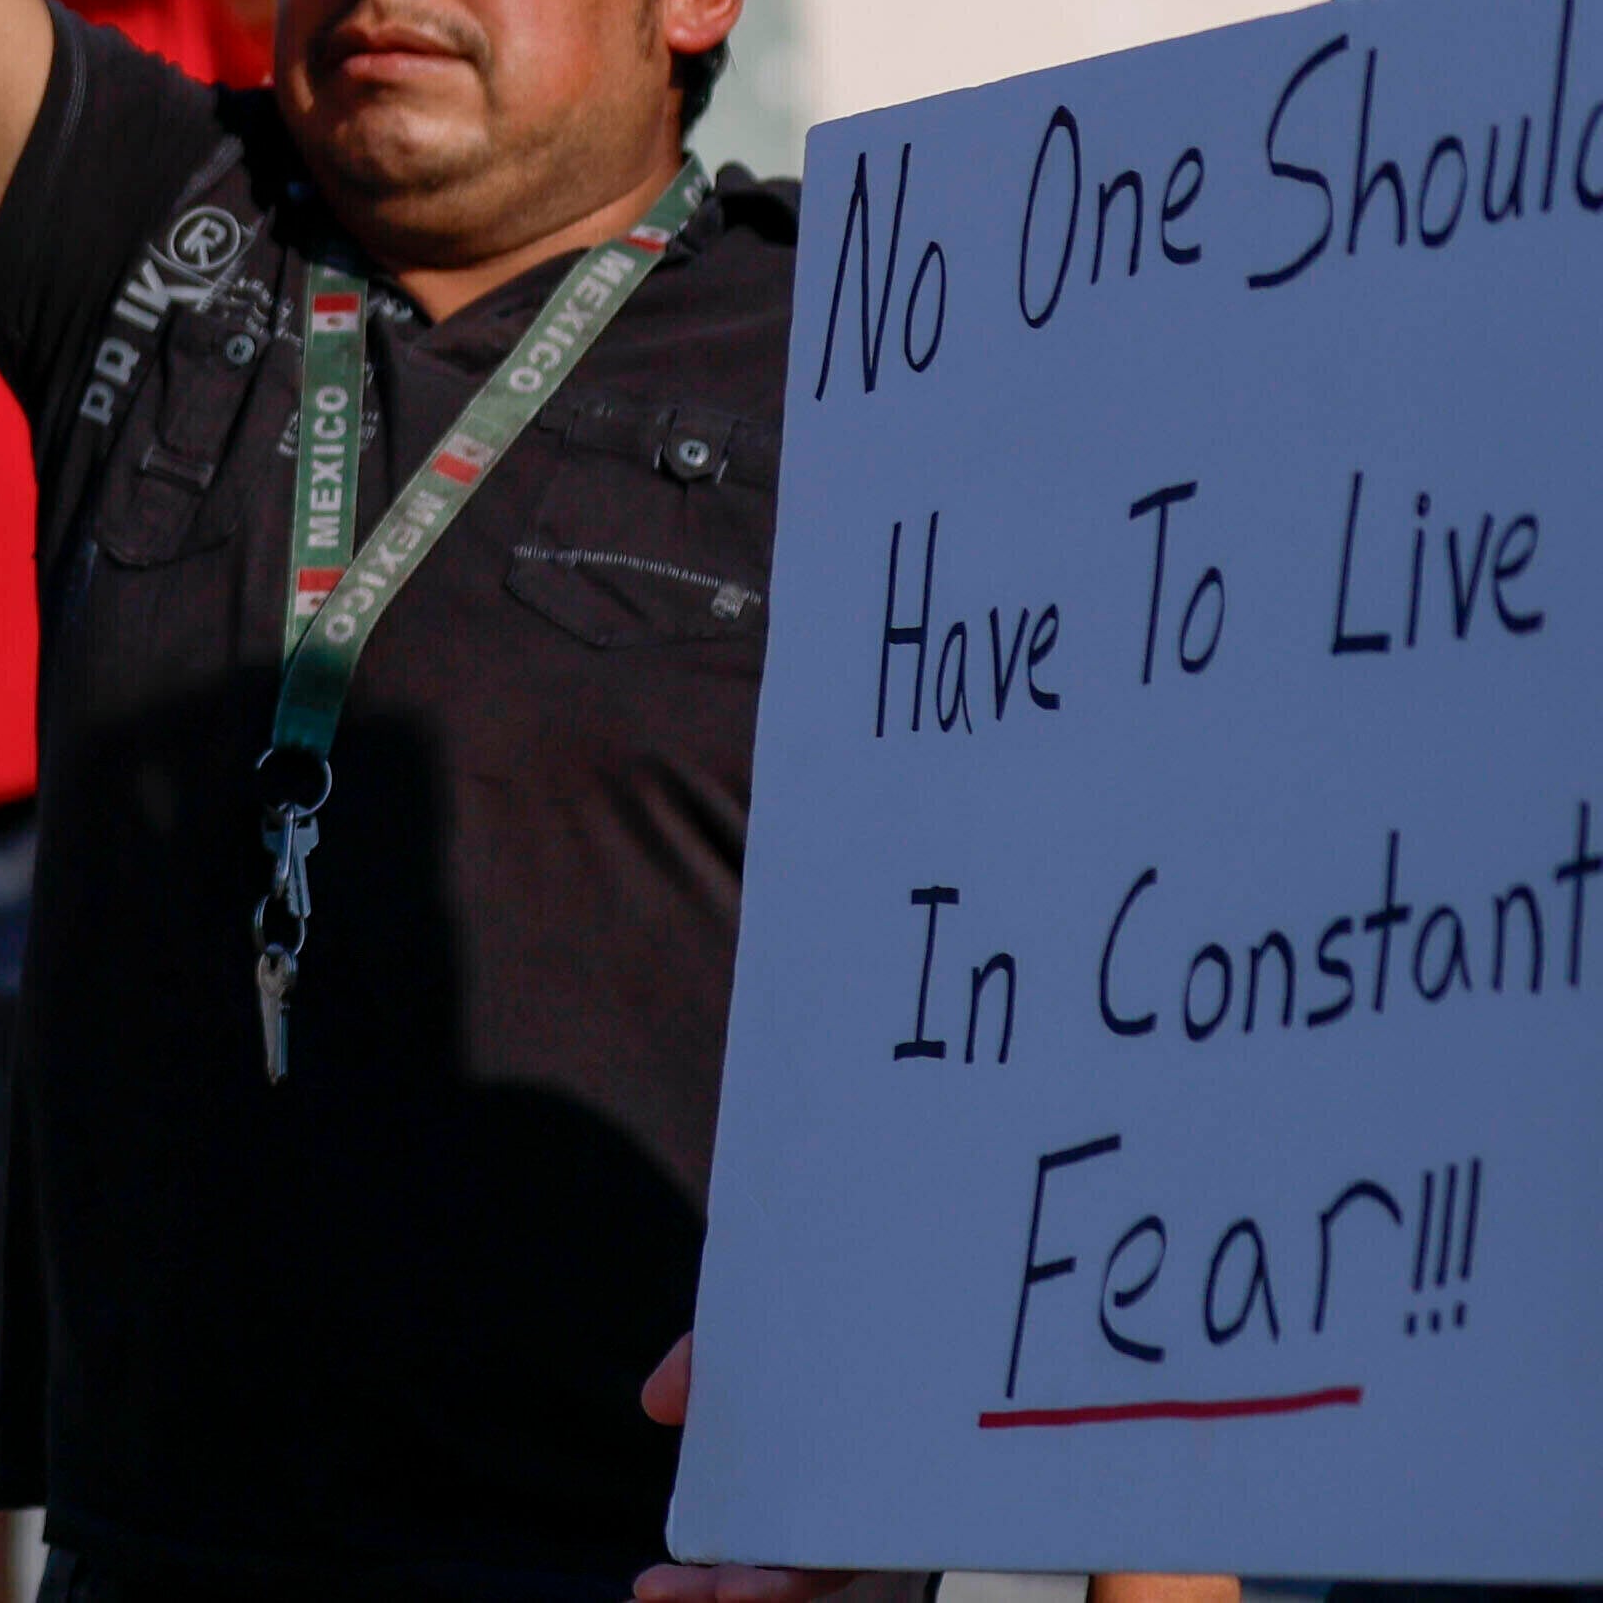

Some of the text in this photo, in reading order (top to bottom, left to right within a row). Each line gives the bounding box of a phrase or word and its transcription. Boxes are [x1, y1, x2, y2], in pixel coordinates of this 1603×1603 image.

[509, 249, 636, 393] MEXICO
[814, 142, 947, 402] No
[1018, 104, 1205, 330] One
[307, 385, 349, 548] MEXICO
[325, 489, 447, 644] MEXICO
[875, 471, 1545, 738] Have To Live
[893, 800, 1603, 1065] In Constant
[1004, 1133, 1482, 1400] Fear!!!
